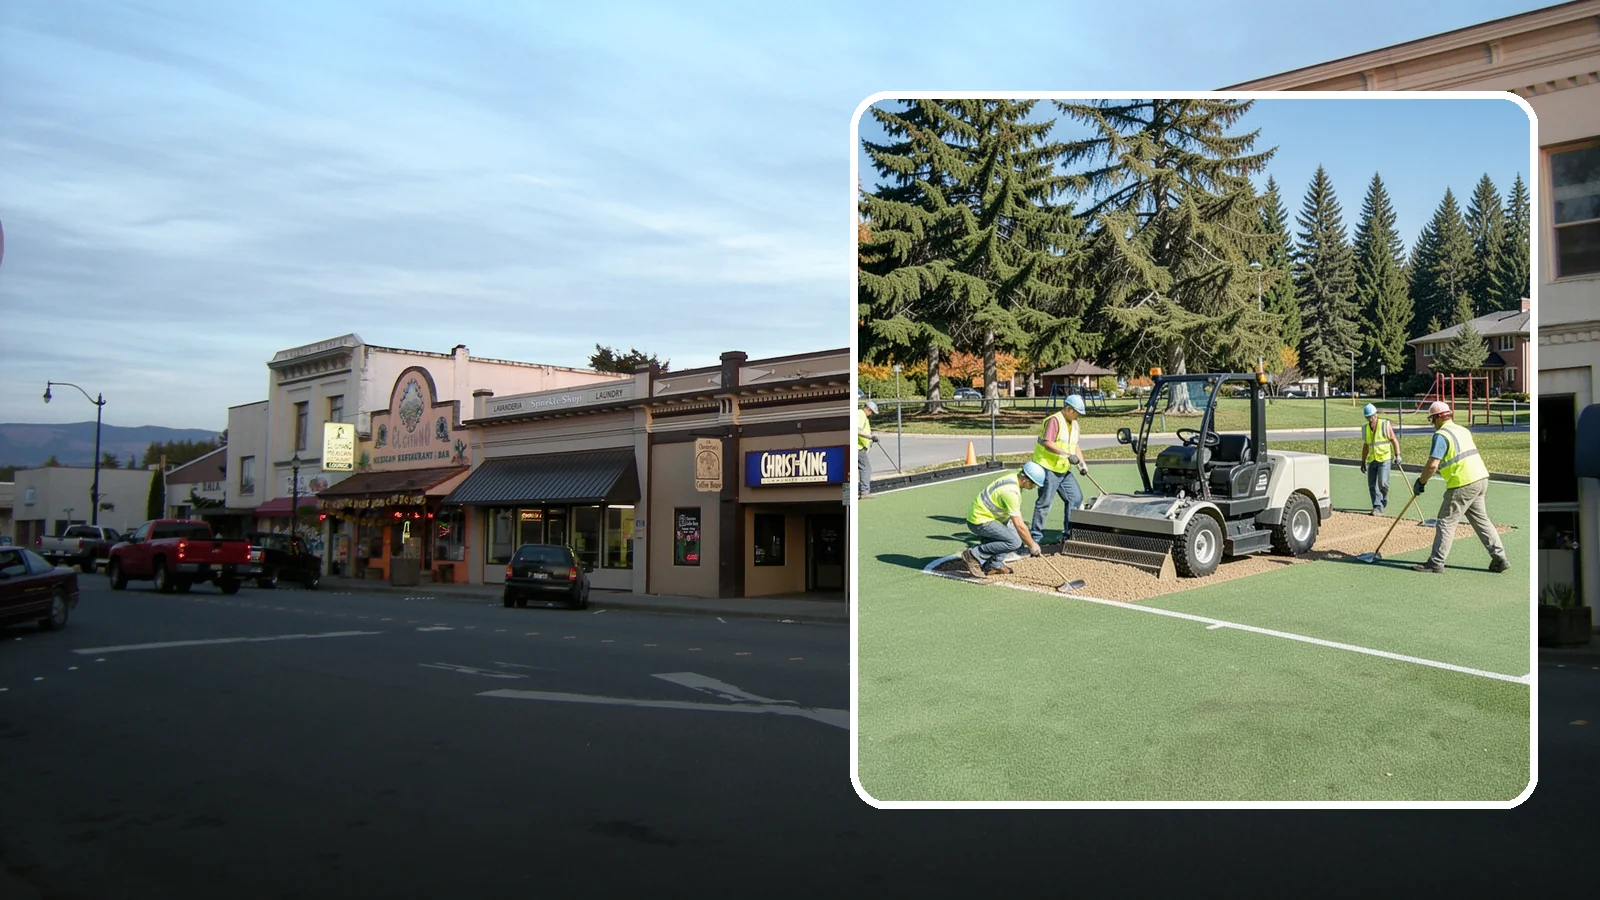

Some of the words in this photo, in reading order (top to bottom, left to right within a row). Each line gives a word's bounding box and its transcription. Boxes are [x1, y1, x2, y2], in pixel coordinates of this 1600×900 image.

[530, 397, 561, 408] Sparkle
[562, 394, 582, 405] Shop
[595, 389, 623, 400] LAUNDRY
[493, 402, 522, 413] LAVANDERIA
[373, 455, 396, 464] MEXICAN
[398, 451, 434, 462] RESTAURANT
[438, 450, 450, 459] BAR
[761, 452, 797, 478] CHRIST
[799, 450, 827, 476] KING
